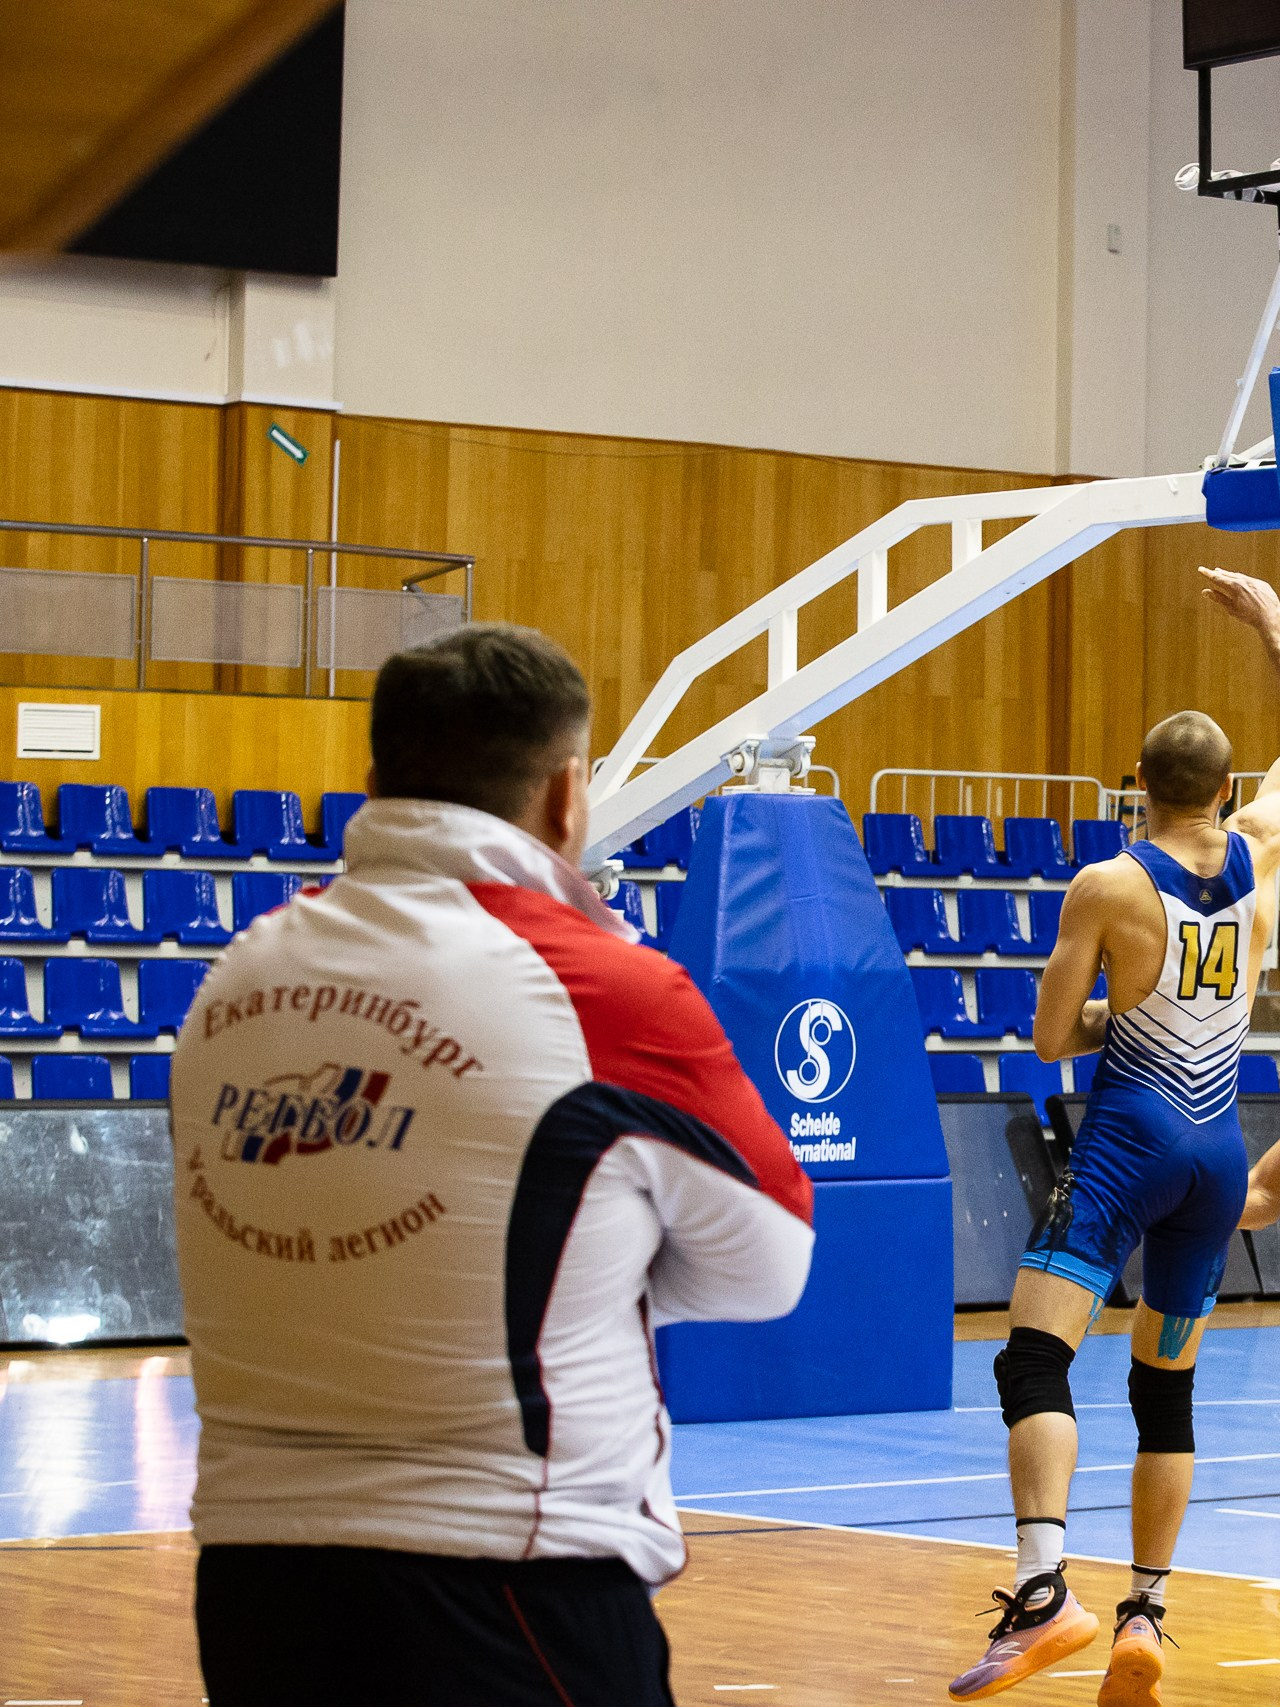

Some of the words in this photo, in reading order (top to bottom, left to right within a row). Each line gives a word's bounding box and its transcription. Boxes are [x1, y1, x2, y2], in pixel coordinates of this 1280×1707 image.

[1177, 921, 1239, 1000] 14
[202, 985, 484, 1078] Екатеринбург
[789, 1136, 857, 1163] ernational
[790, 1111, 841, 1138] Schelde
[328, 1191, 446, 1262] легион
